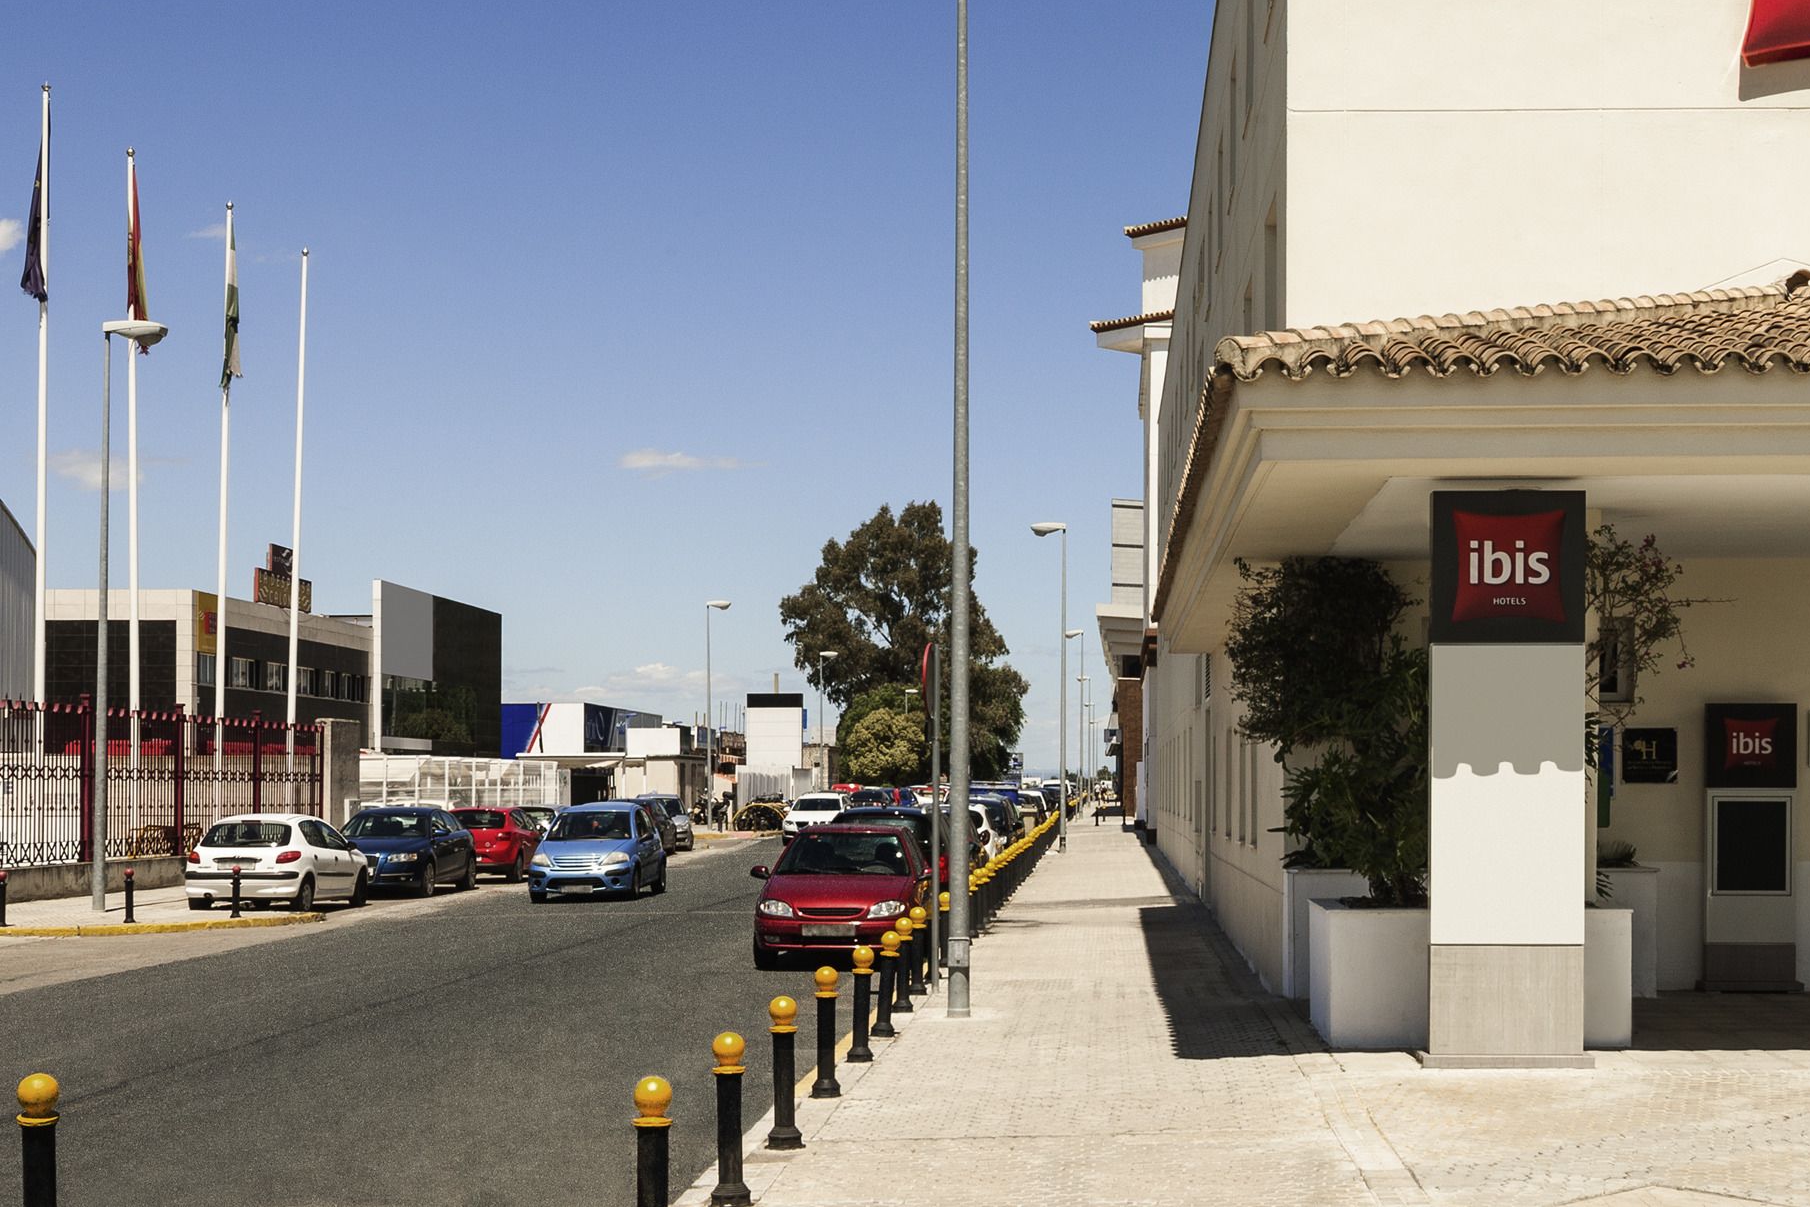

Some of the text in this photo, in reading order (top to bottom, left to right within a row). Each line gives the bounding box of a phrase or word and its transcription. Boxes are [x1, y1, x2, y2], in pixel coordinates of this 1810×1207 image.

[1469, 540, 1550, 585] ibis
[1493, 597, 1526, 605] HOTELS
[1732, 732, 1773, 754] ibis
